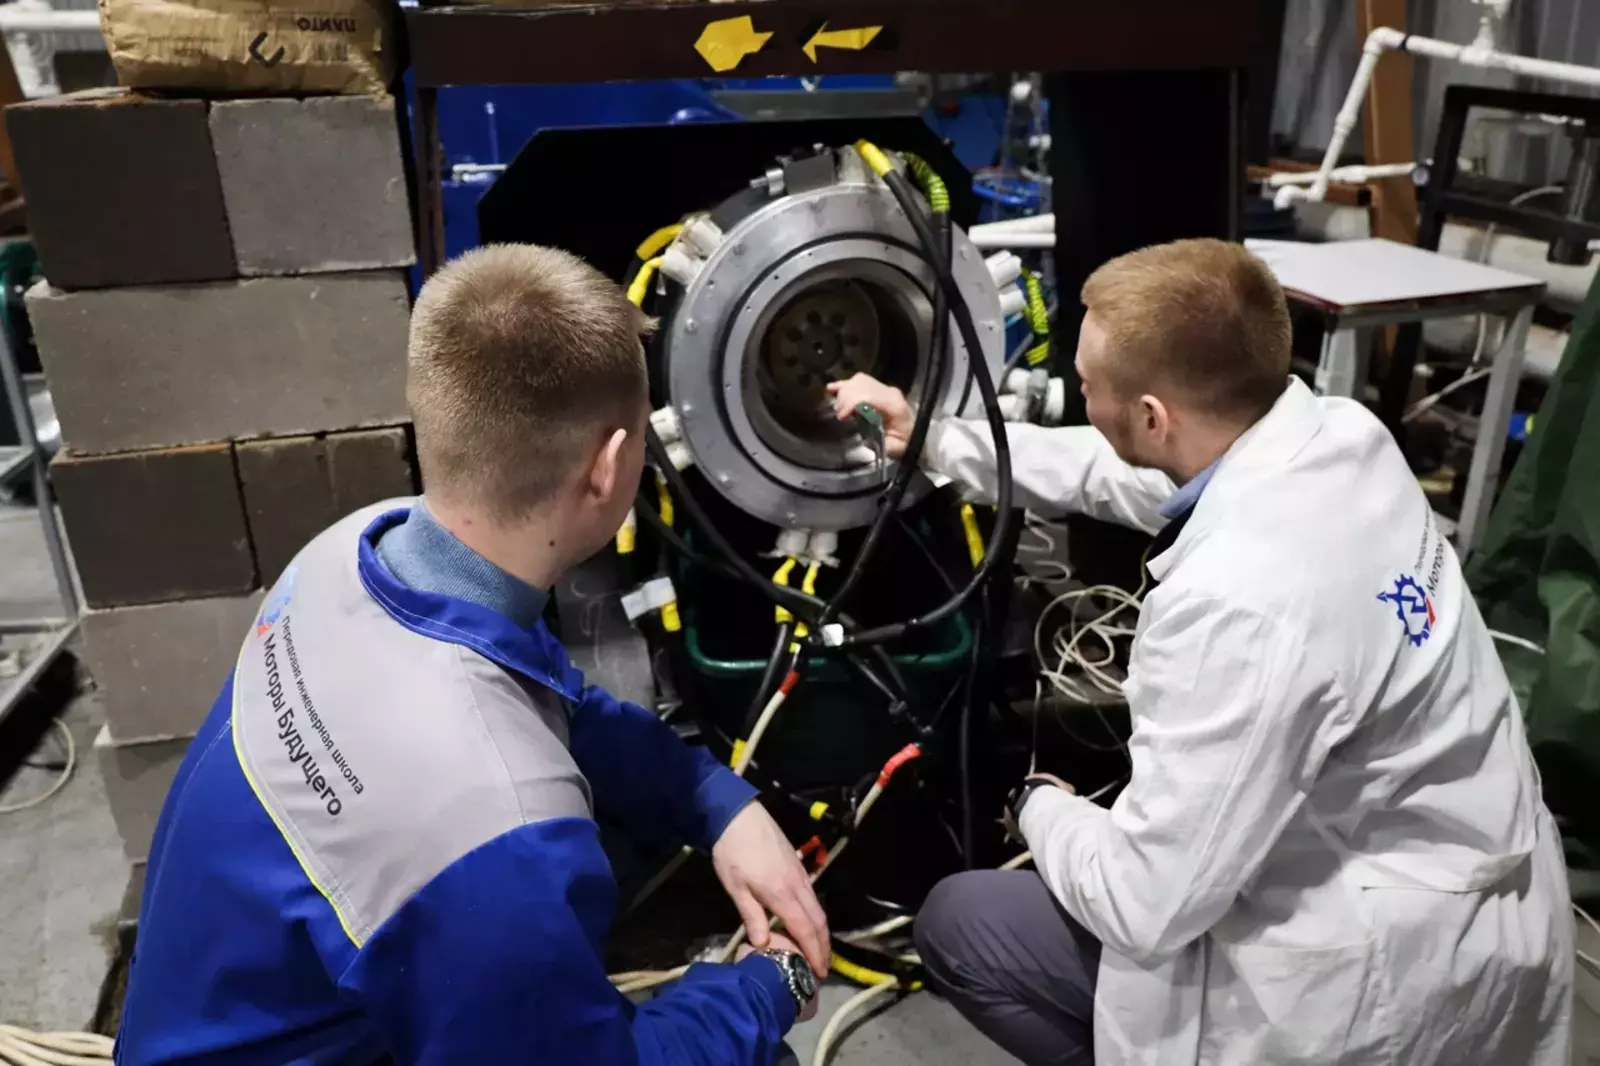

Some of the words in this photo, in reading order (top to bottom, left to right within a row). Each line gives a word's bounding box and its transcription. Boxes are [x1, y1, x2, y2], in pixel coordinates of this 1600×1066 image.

[263, 632, 286, 713] Моторы
[277, 706, 342, 817] Будущего
[281, 615, 302, 679] Передовая
[296, 677, 335, 751] инженерная
[331, 748, 364, 795] школа
